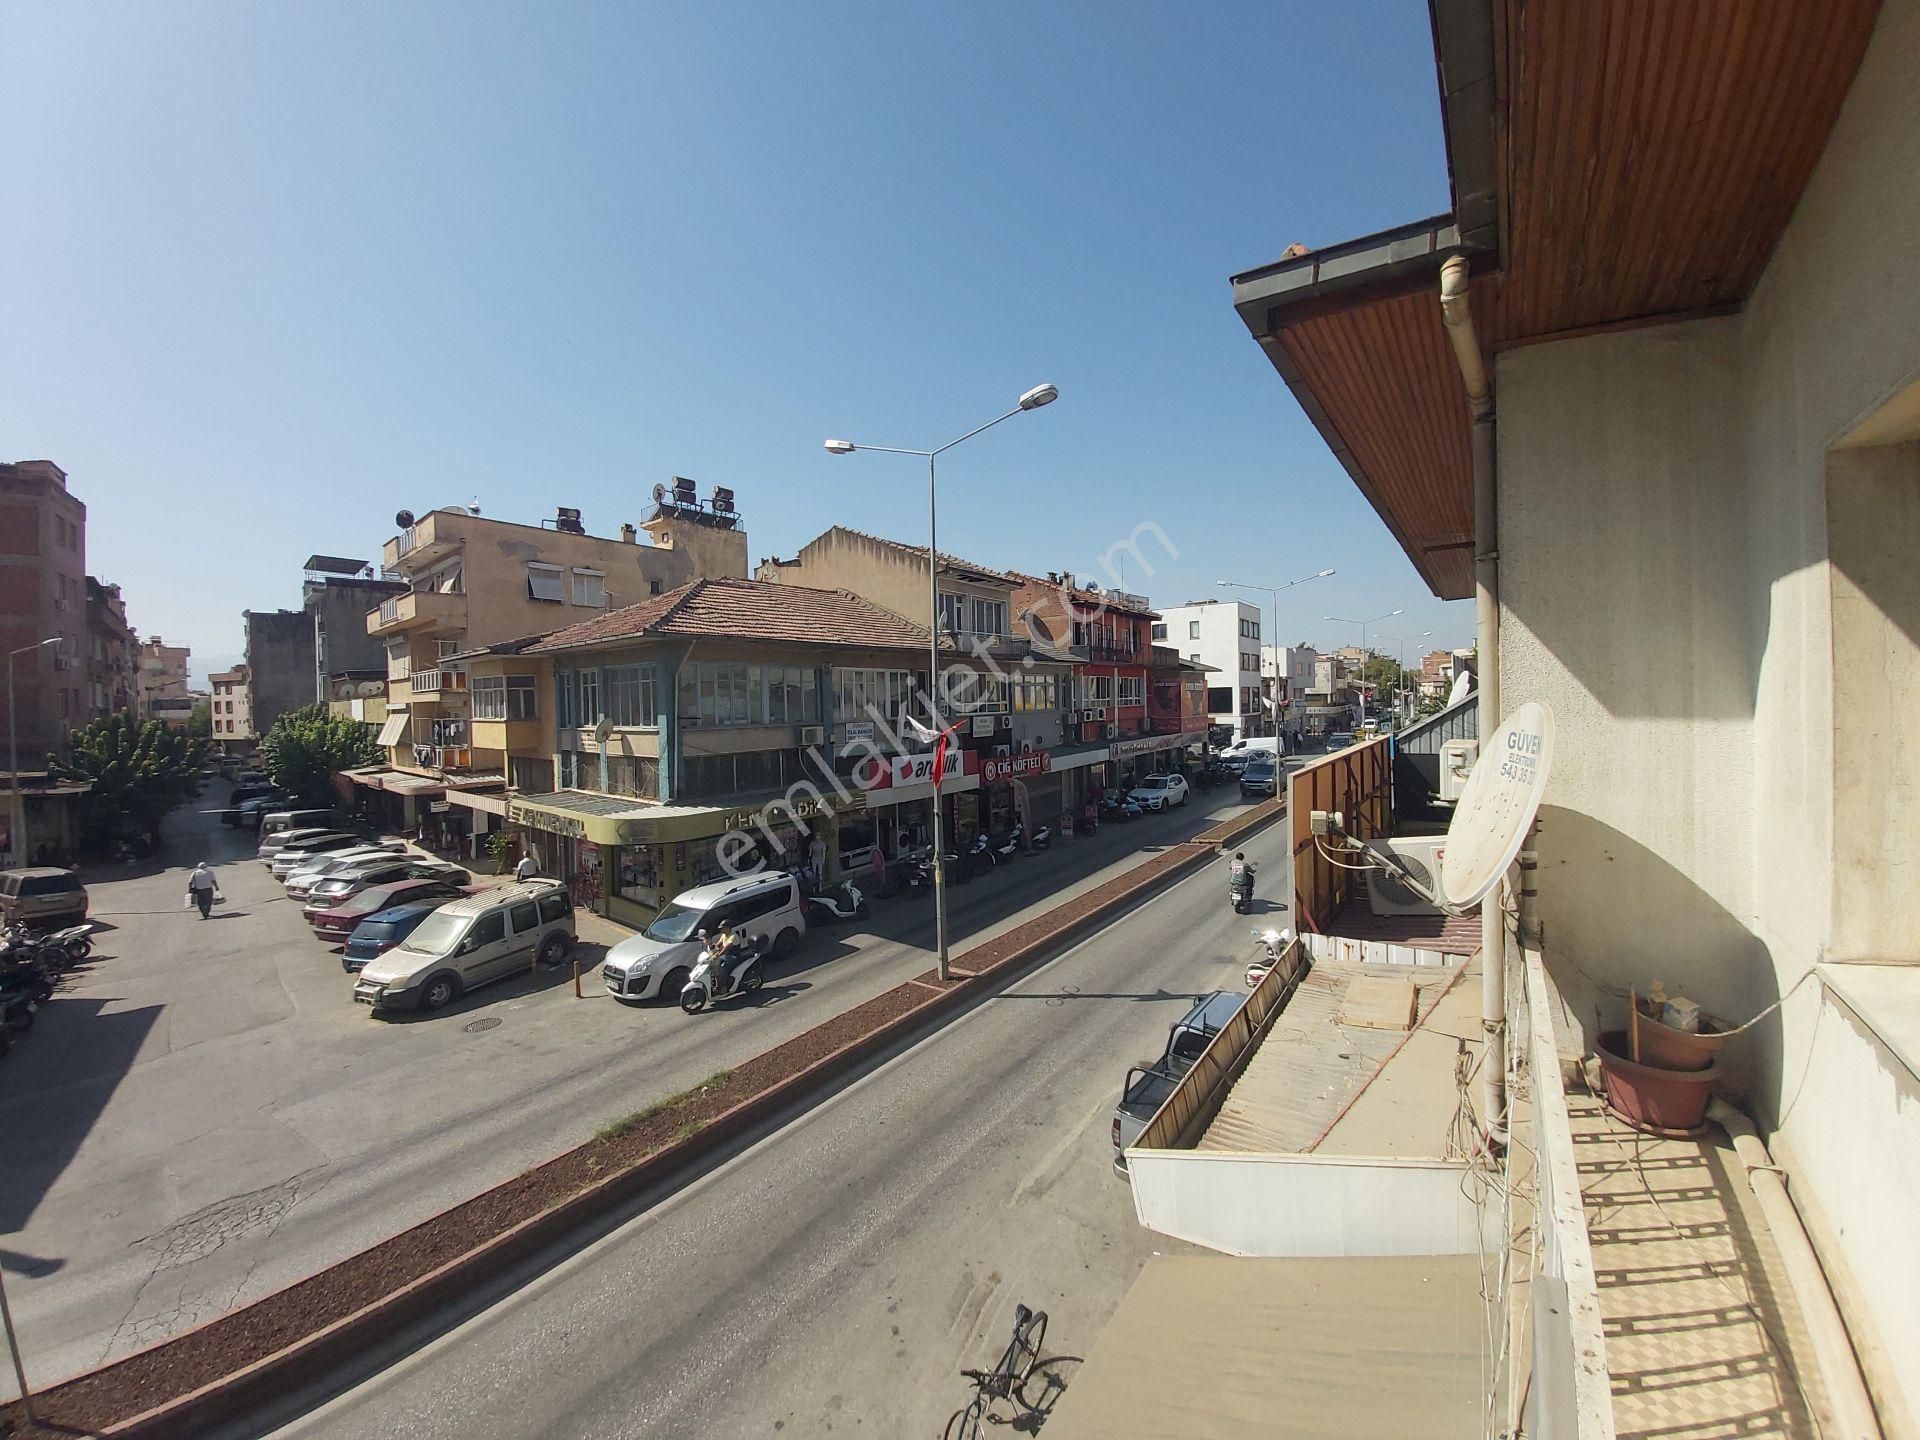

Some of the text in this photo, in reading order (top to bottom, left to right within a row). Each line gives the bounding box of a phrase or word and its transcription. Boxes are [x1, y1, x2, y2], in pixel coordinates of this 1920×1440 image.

[1508, 729, 1542, 755] GÜVEN
[997, 754, 1041, 777] ÇİĞ KÖFTECİ
[1501, 763, 1518, 780] 543
